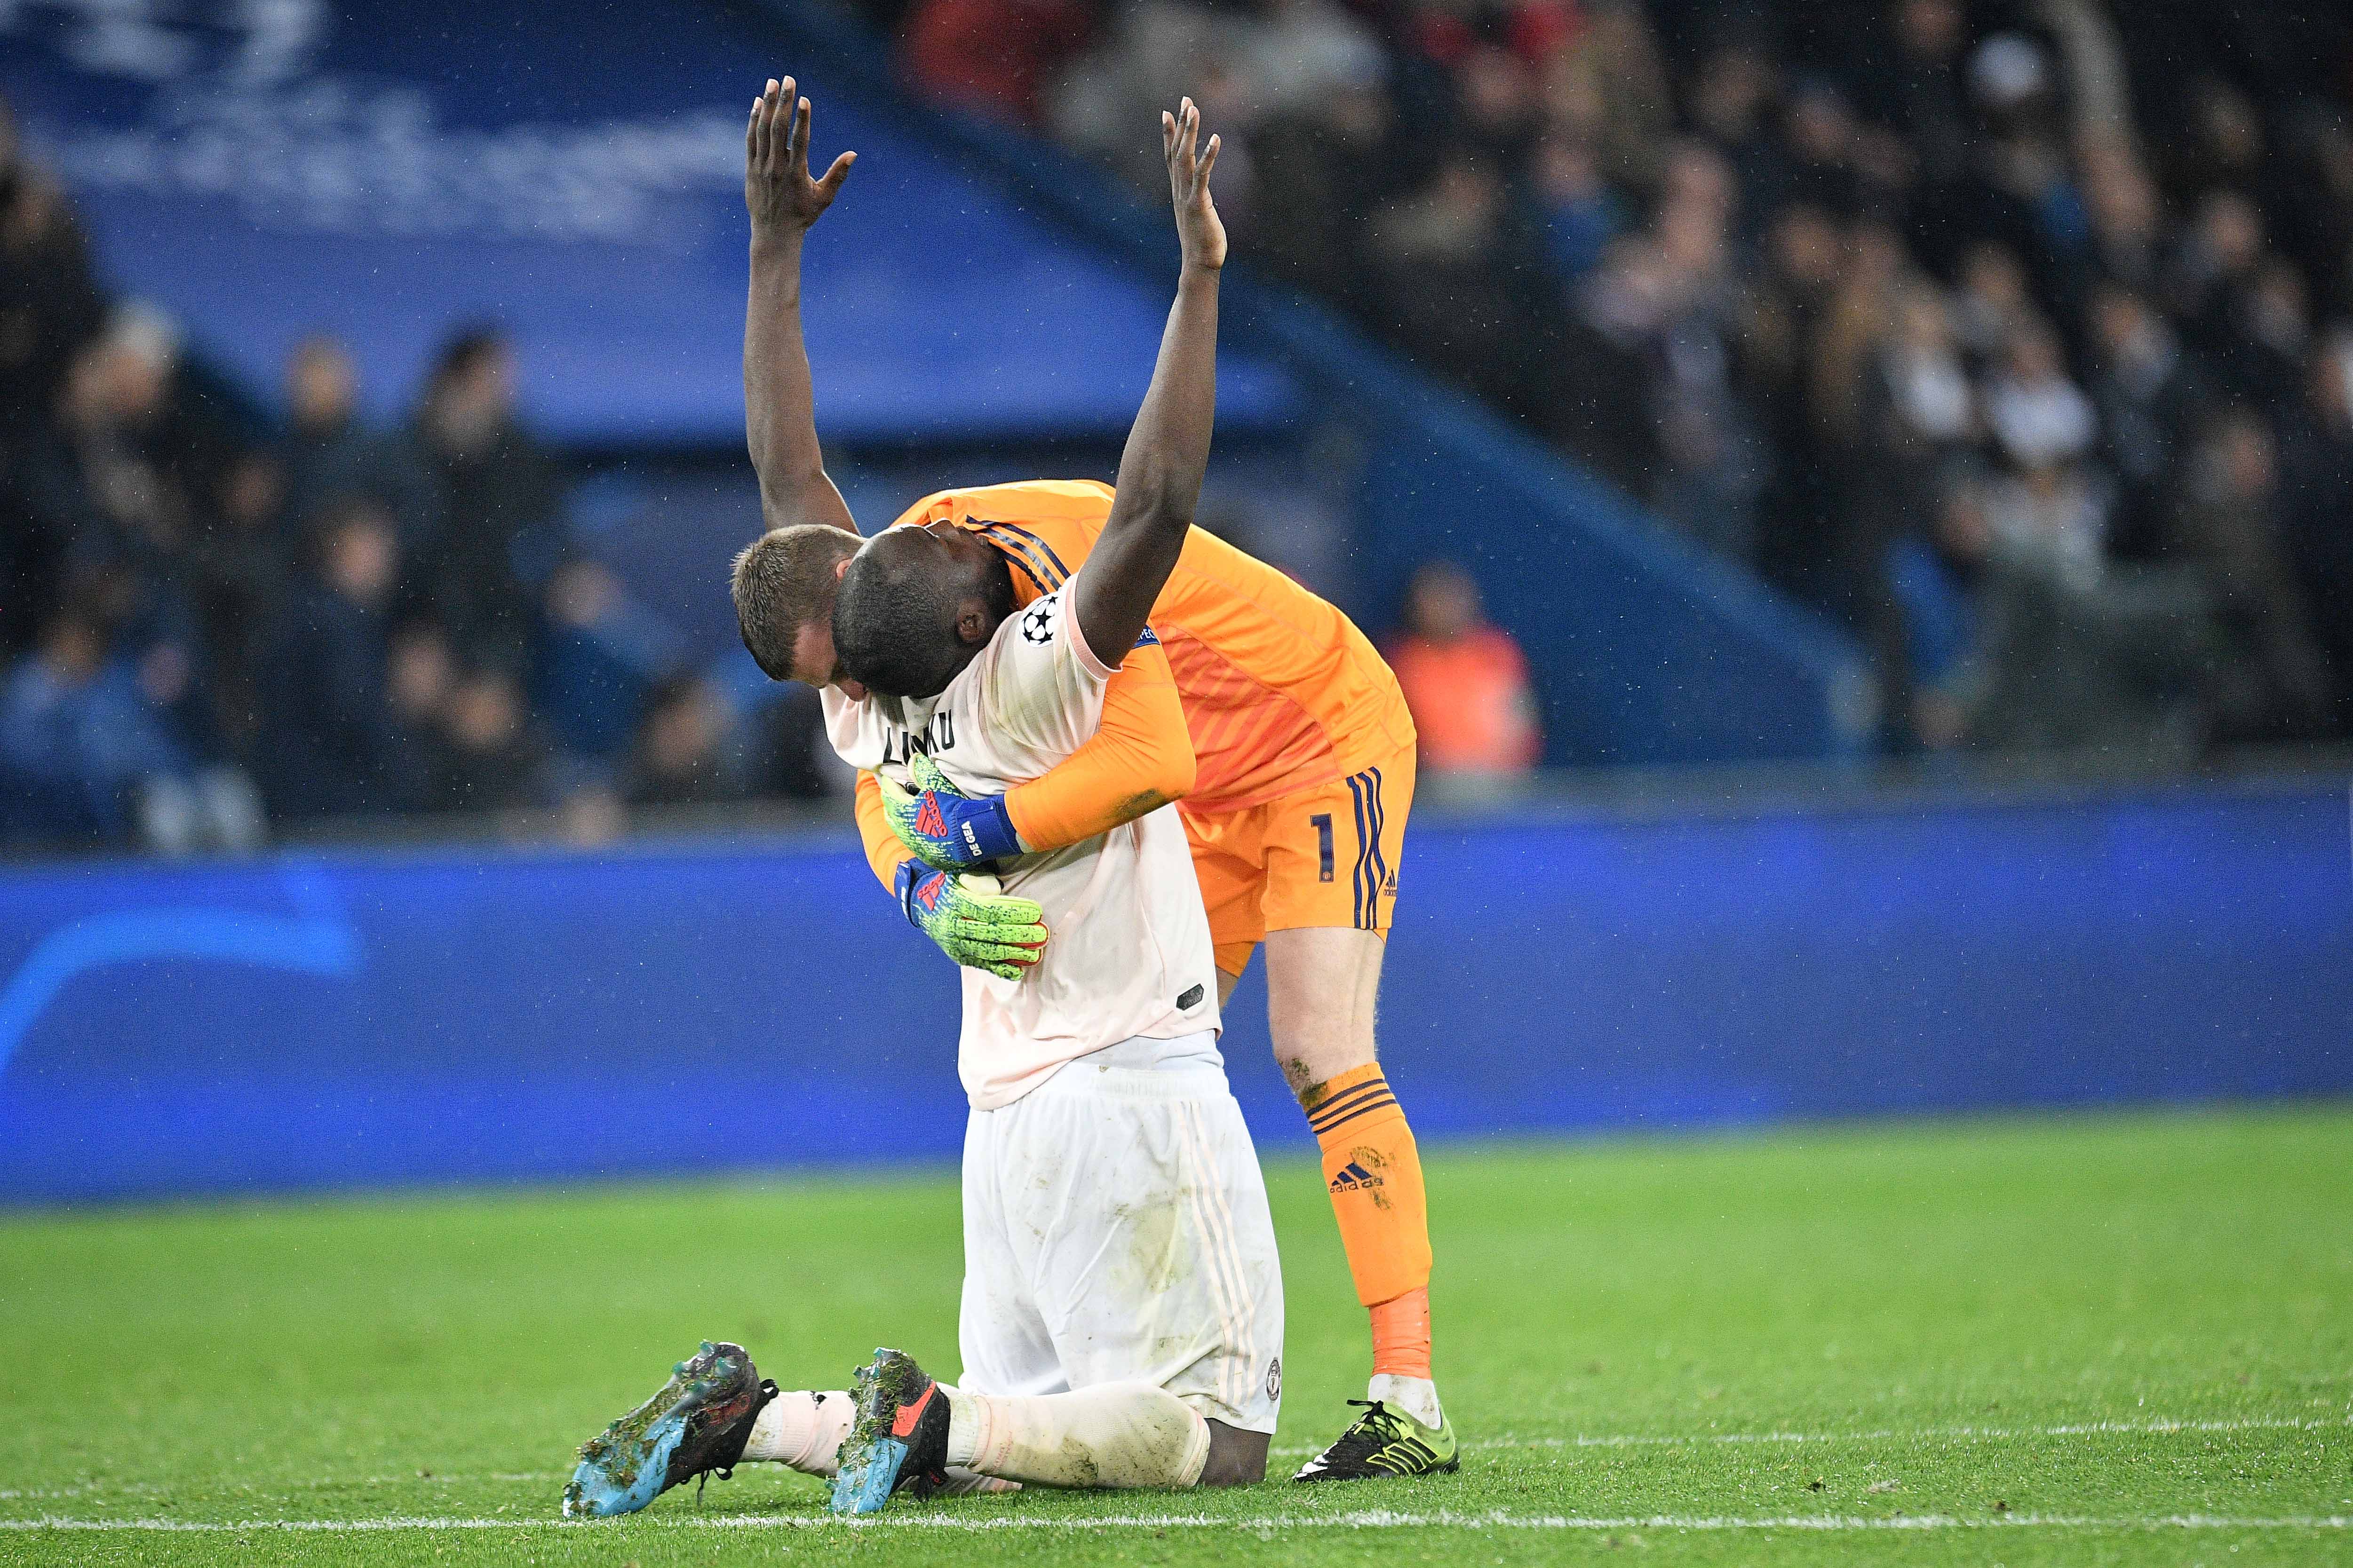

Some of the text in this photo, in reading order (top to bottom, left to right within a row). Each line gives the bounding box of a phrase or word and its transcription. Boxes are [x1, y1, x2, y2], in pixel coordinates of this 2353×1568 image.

[961, 821, 983, 856] DE GEA
[1310, 813, 1335, 884] 1
